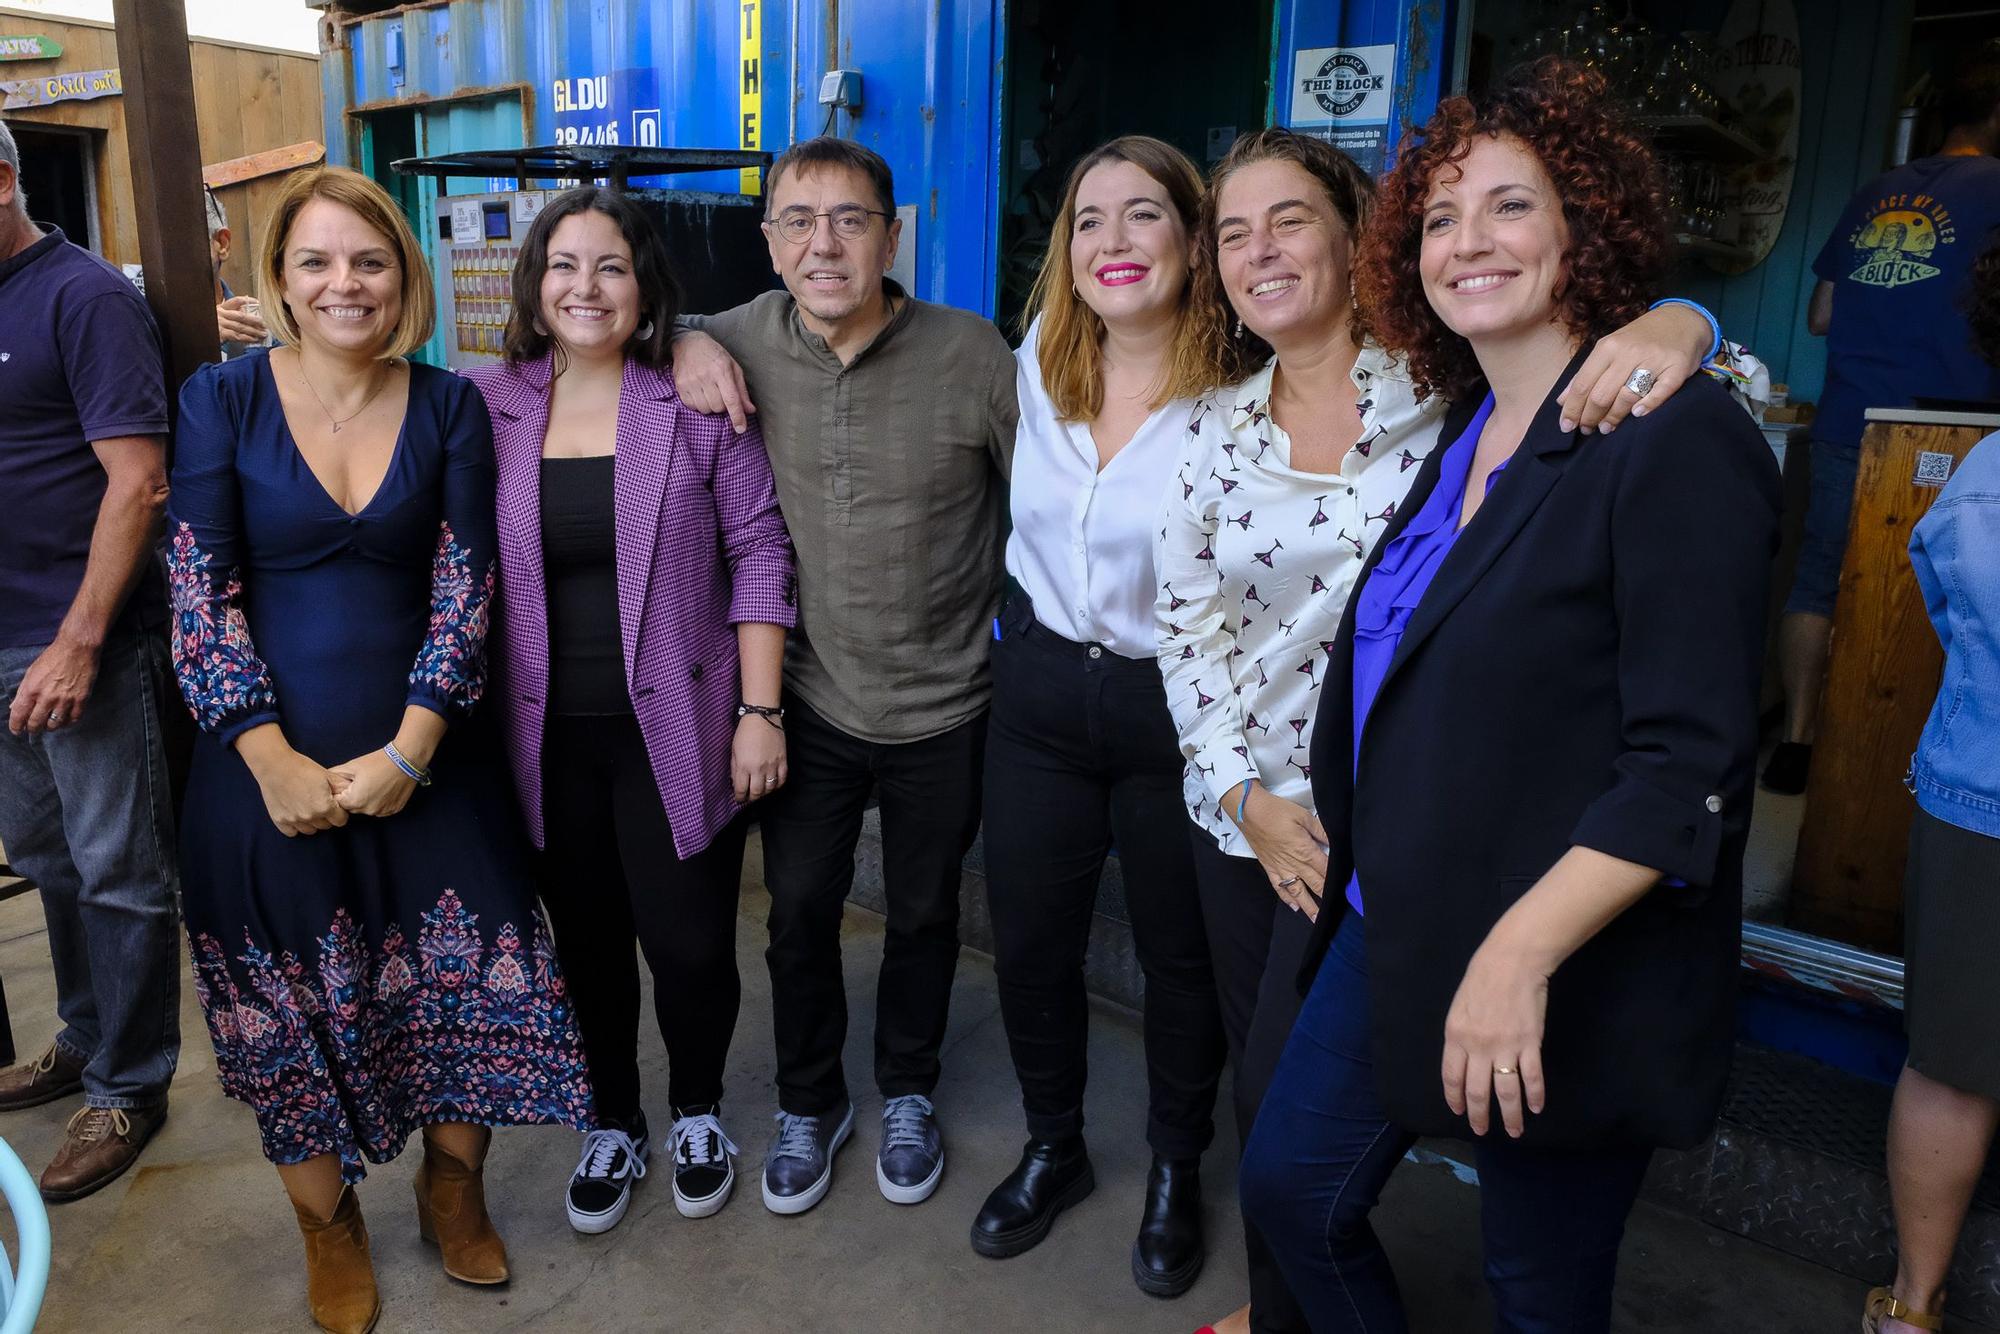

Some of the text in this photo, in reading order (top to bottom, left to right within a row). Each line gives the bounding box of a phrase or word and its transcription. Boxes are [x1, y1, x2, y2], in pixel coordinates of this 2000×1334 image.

[1325, 57, 1363, 71] MY PLACE
[93, 72, 113, 92] out
[743, 4, 759, 148] THE
[1302, 75, 1384, 92] THE BLOCK
[553, 76, 607, 112] GLDU
[1322, 98, 1360, 113] MY RULES
[1865, 262, 1921, 283] BLOCK
